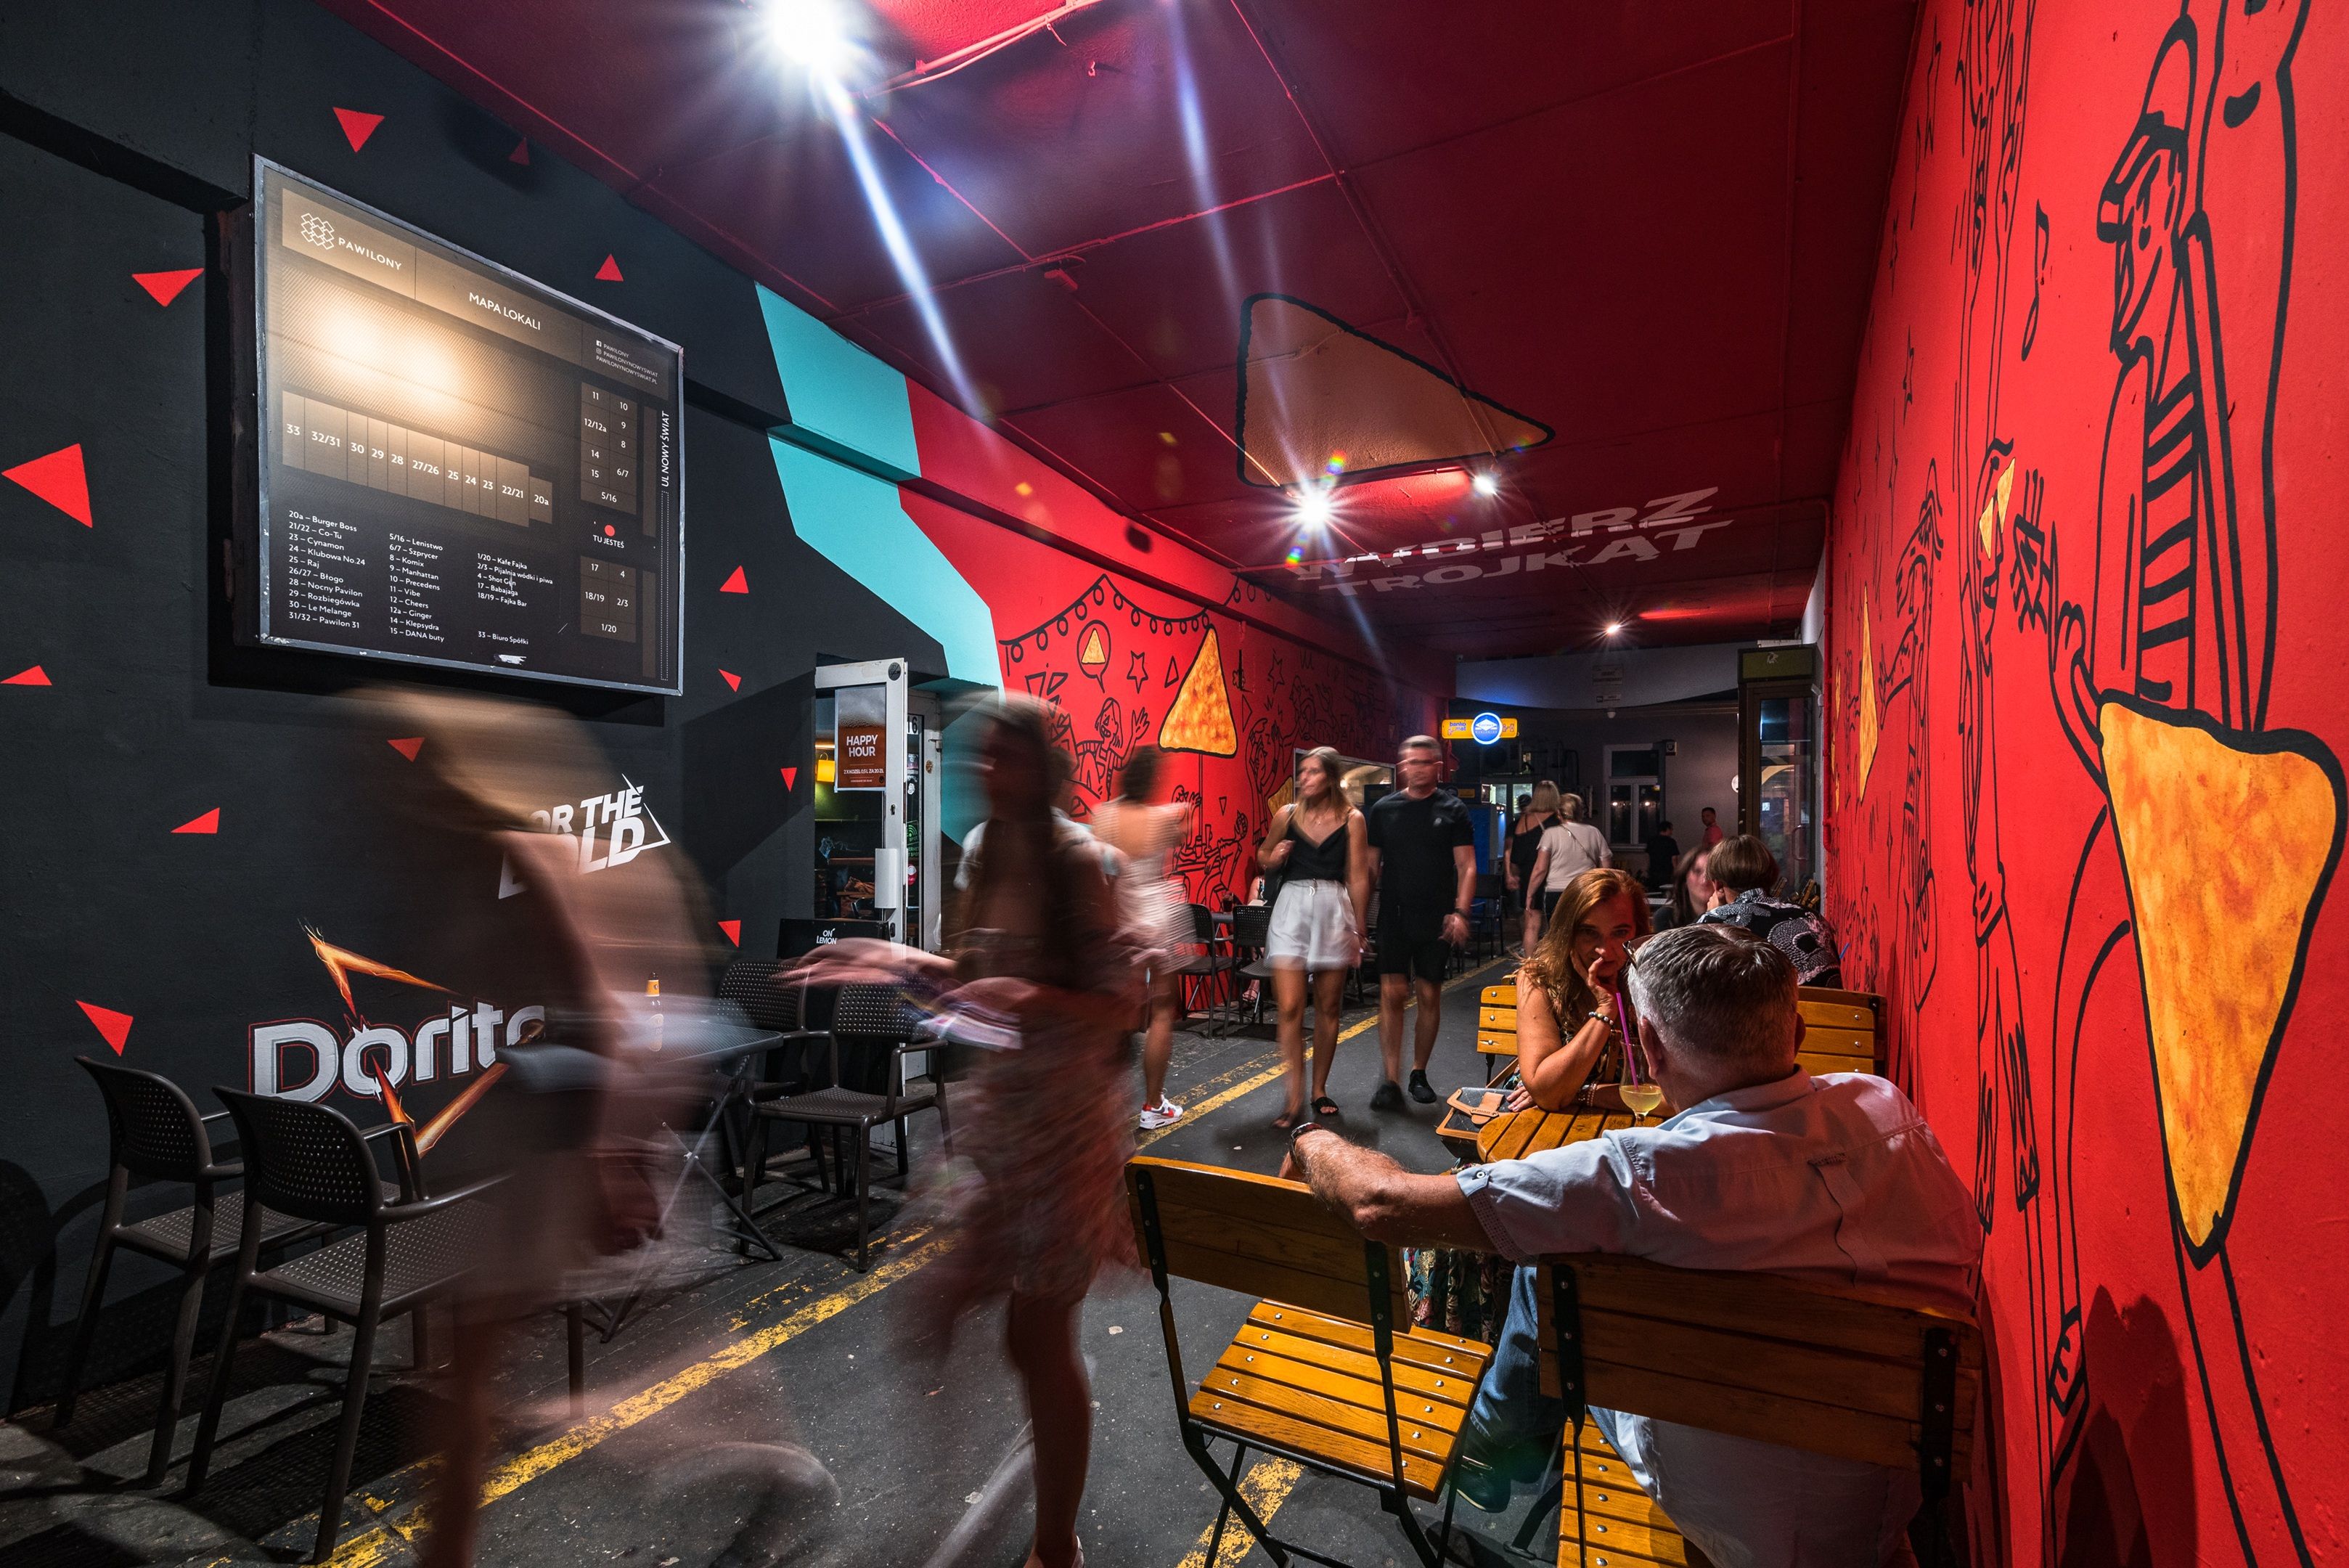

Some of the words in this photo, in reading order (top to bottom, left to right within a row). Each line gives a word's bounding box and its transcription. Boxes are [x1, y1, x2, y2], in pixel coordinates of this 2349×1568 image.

[339, 237, 401, 269] PAWILONY
[470, 293, 501, 314] MAPA
[504, 307, 540, 330] LOKALI
[604, 344, 629, 358] PAWILONY
[593, 391, 598, 400] 11
[287, 424, 300, 435] 33
[584, 418, 606, 432] 12/12a
[660, 411, 669, 441] ŚWIAT
[312, 431, 340, 447] 32/31
[351, 443, 364, 454] 30
[372, 449, 384, 459] 29
[592, 449, 599, 458] 14
[391, 454, 404, 465] 28
[412, 460, 438, 475] 27/26
[617, 468, 629, 477] 6/7
[448, 470, 458, 480] 25
[465, 475, 476, 485] 24
[483, 480, 493, 489] 23
[661, 476, 669, 487] UL
[502, 486, 523, 498] 22/21
[602, 491, 616, 502] 5/16
[534, 494, 549, 505] 20a
[289, 510, 303, 520] 20a
[312, 516, 338, 527] Burger
[340, 522, 357, 531] Boss
[289, 521, 309, 532] 21/22
[319, 528, 342, 539] Co-Tu
[307, 537, 344, 550] Cynamon
[390, 534, 404, 542] 5/16
[412, 539, 443, 550] Lenistwo
[603, 538, 624, 548] JESTEŚ
[308, 548, 341, 560] Klubowa
[343, 555, 365, 565] No.24
[409, 548, 438, 560] Szprycer
[308, 559, 319, 568] Raj
[402, 557, 424, 567] Komix
[512, 560, 527, 569] Fajka
[289, 566, 311, 576] 26/27
[320, 573, 343, 584] Błogo
[402, 567, 438, 580] Manhattan
[308, 581, 333, 593] Nocny
[335, 587, 362, 597] Pavilon
[406, 578, 440, 590] Precedens
[404, 588, 420, 597] Vibe
[491, 584, 518, 596] Babajaga
[308, 593, 360, 608] Rozbiegówka
[585, 592, 605, 602] 18/19
[617, 598, 628, 607] 2/3
[405, 599, 428, 608] Cheers
[319, 605, 351, 618] Melange
[409, 610, 432, 620] Ginger
[289, 611, 310, 621] 31/32
[319, 616, 350, 626] Pawilon
[406, 620, 439, 630] Klepsydra
[602, 624, 616, 632] 1/20
[406, 629, 428, 639] DANA
[429, 634, 444, 642] buty
[510, 636, 528, 645] Spółki
[846, 735, 878, 746] HAPPY
[849, 746, 875, 757] HOUR
[580, 785, 645, 828] THE
[816, 936, 837, 944] LEMON
